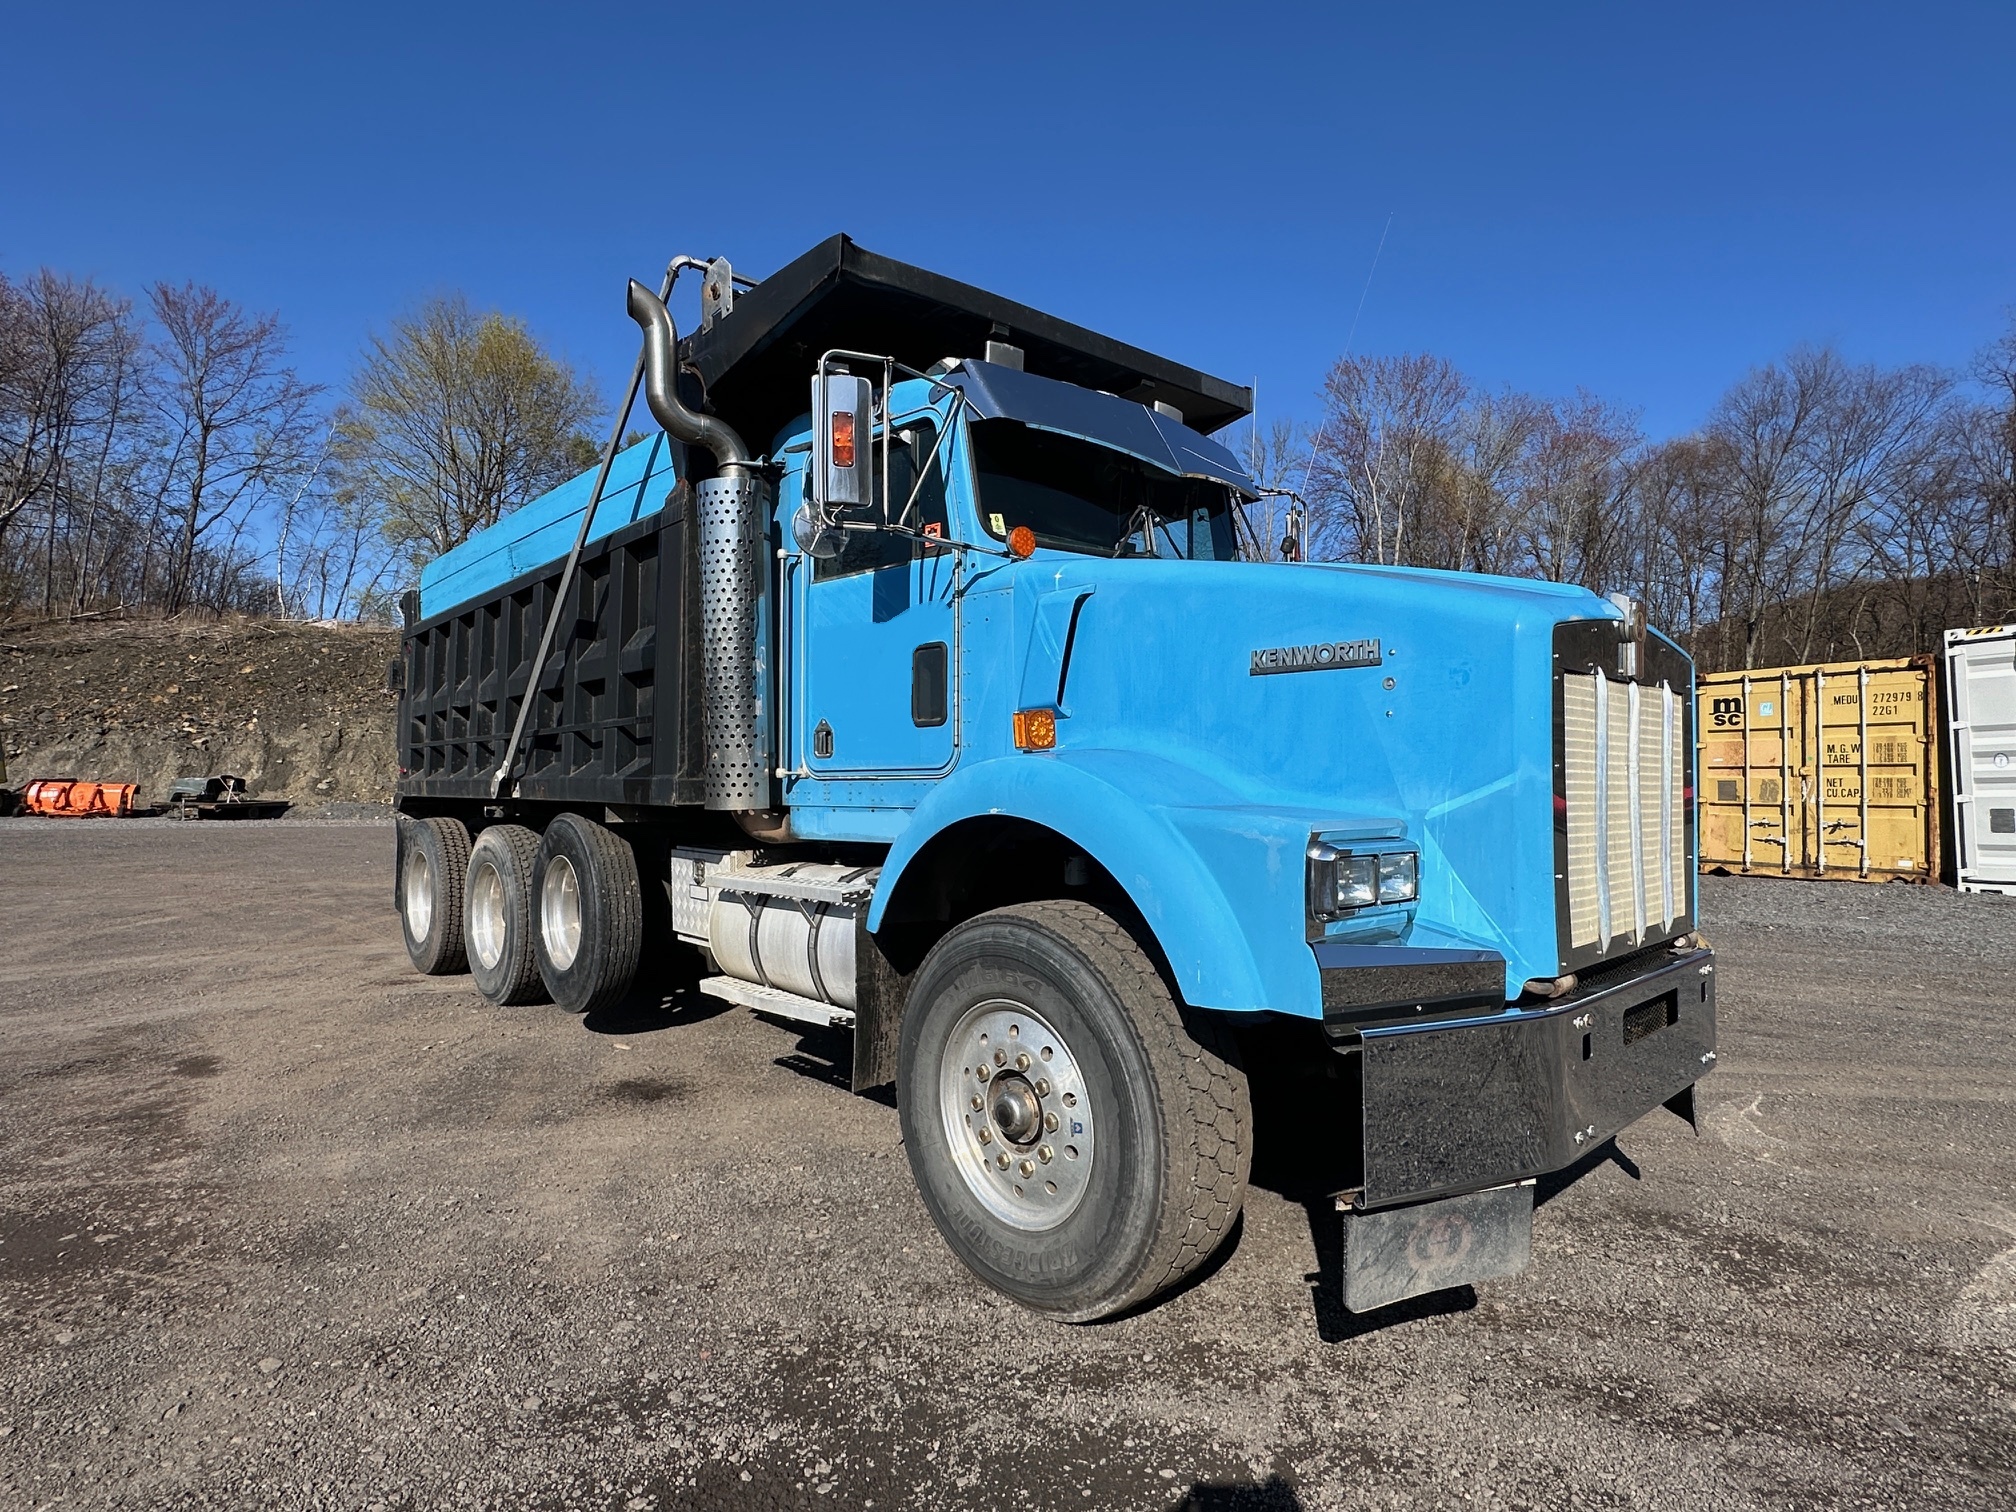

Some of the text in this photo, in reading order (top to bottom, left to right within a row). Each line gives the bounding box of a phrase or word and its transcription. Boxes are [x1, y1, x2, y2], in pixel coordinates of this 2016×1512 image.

[1251, 639, 1381, 669] KENWORTH
[1833, 695, 1858, 705] MEDU
[1872, 692, 1912, 703] 272979
[1872, 706, 1898, 715] 22G1
[1828, 754, 1851, 763] TARE
[1826, 778, 1843, 787] NET
